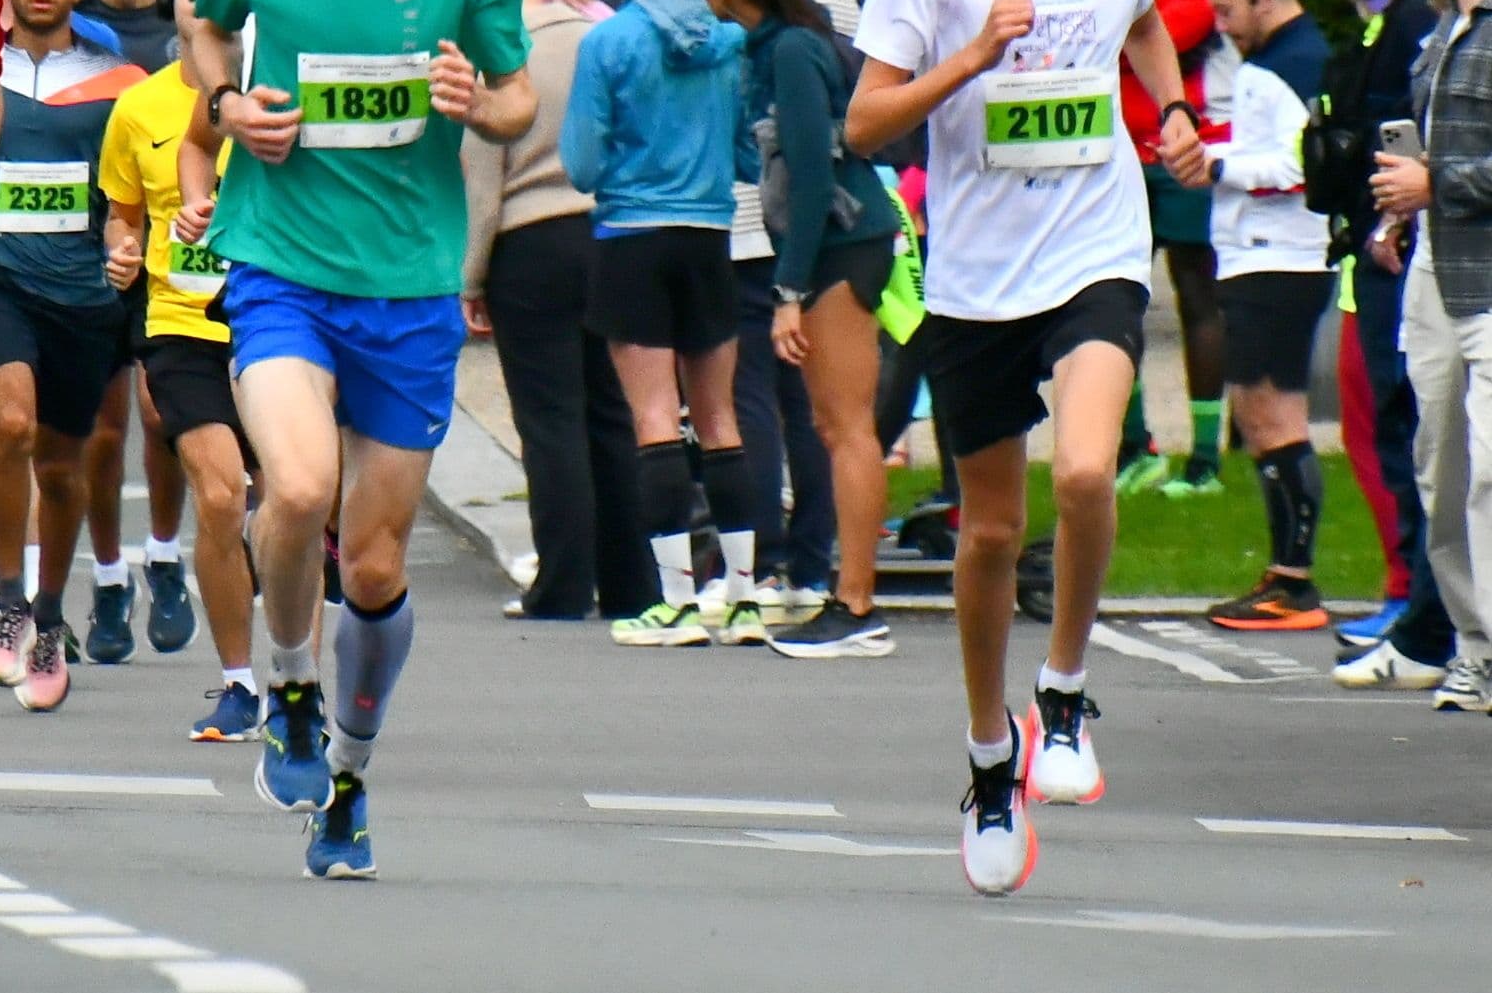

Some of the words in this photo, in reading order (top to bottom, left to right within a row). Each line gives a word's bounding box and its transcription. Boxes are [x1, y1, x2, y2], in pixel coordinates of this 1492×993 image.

[320, 86, 411, 120] 1830
[1008, 101, 1097, 139] 2107
[9, 186, 75, 211] 2325
